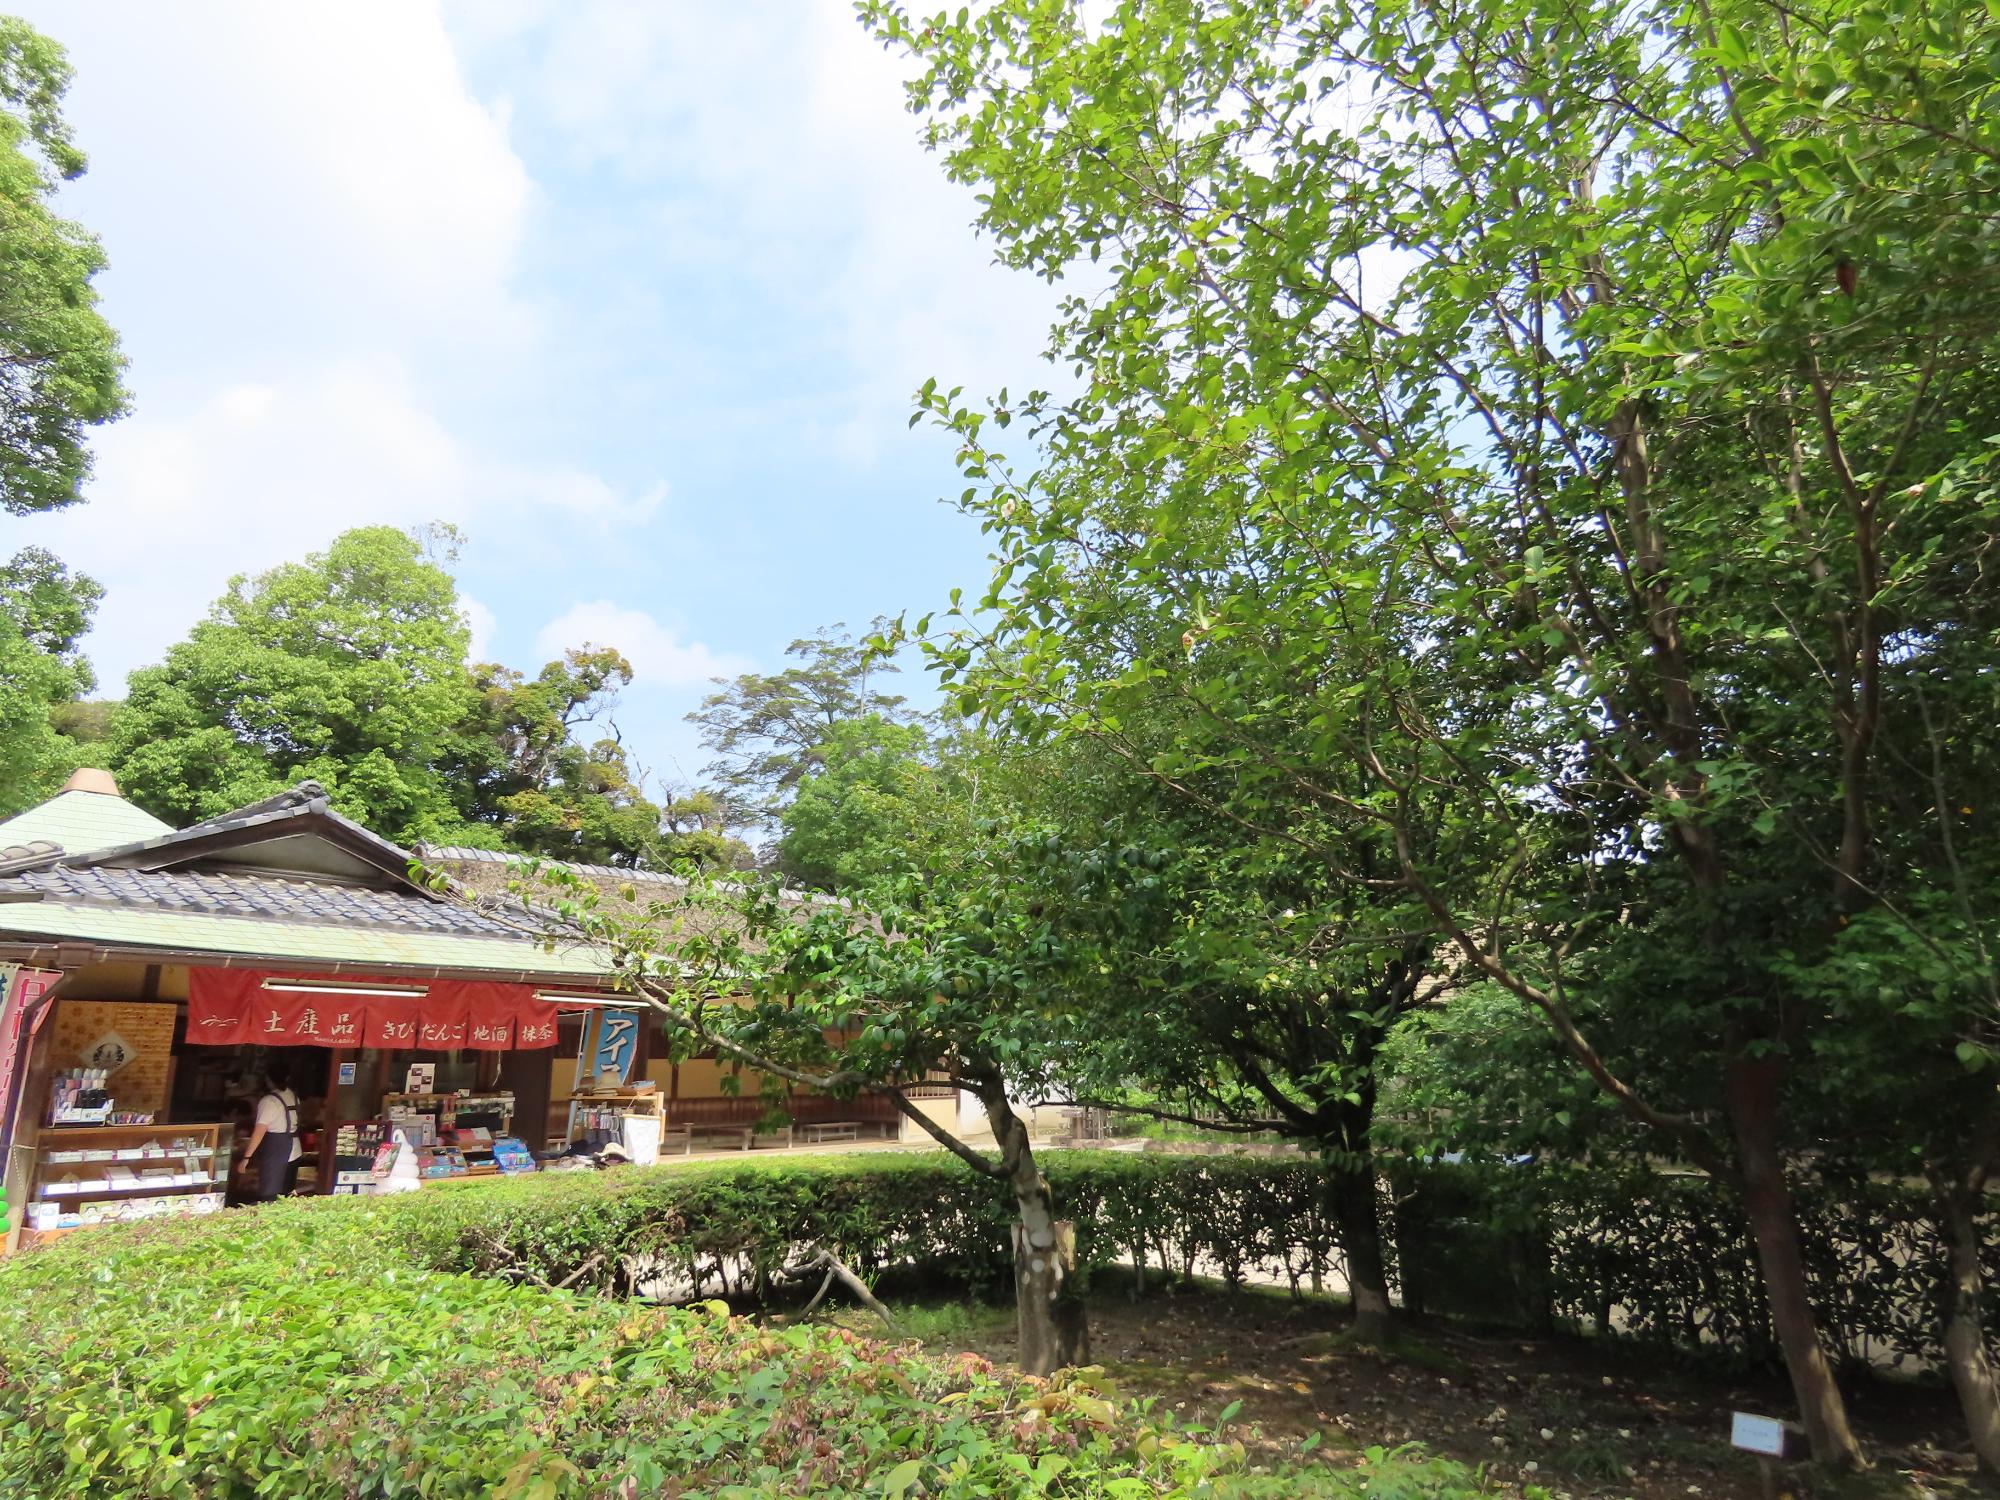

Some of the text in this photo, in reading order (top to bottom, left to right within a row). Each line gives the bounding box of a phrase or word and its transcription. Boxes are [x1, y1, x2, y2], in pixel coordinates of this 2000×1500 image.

[264, 1008, 554, 1042] 土産品 きびだんご 地酒 抹茶
